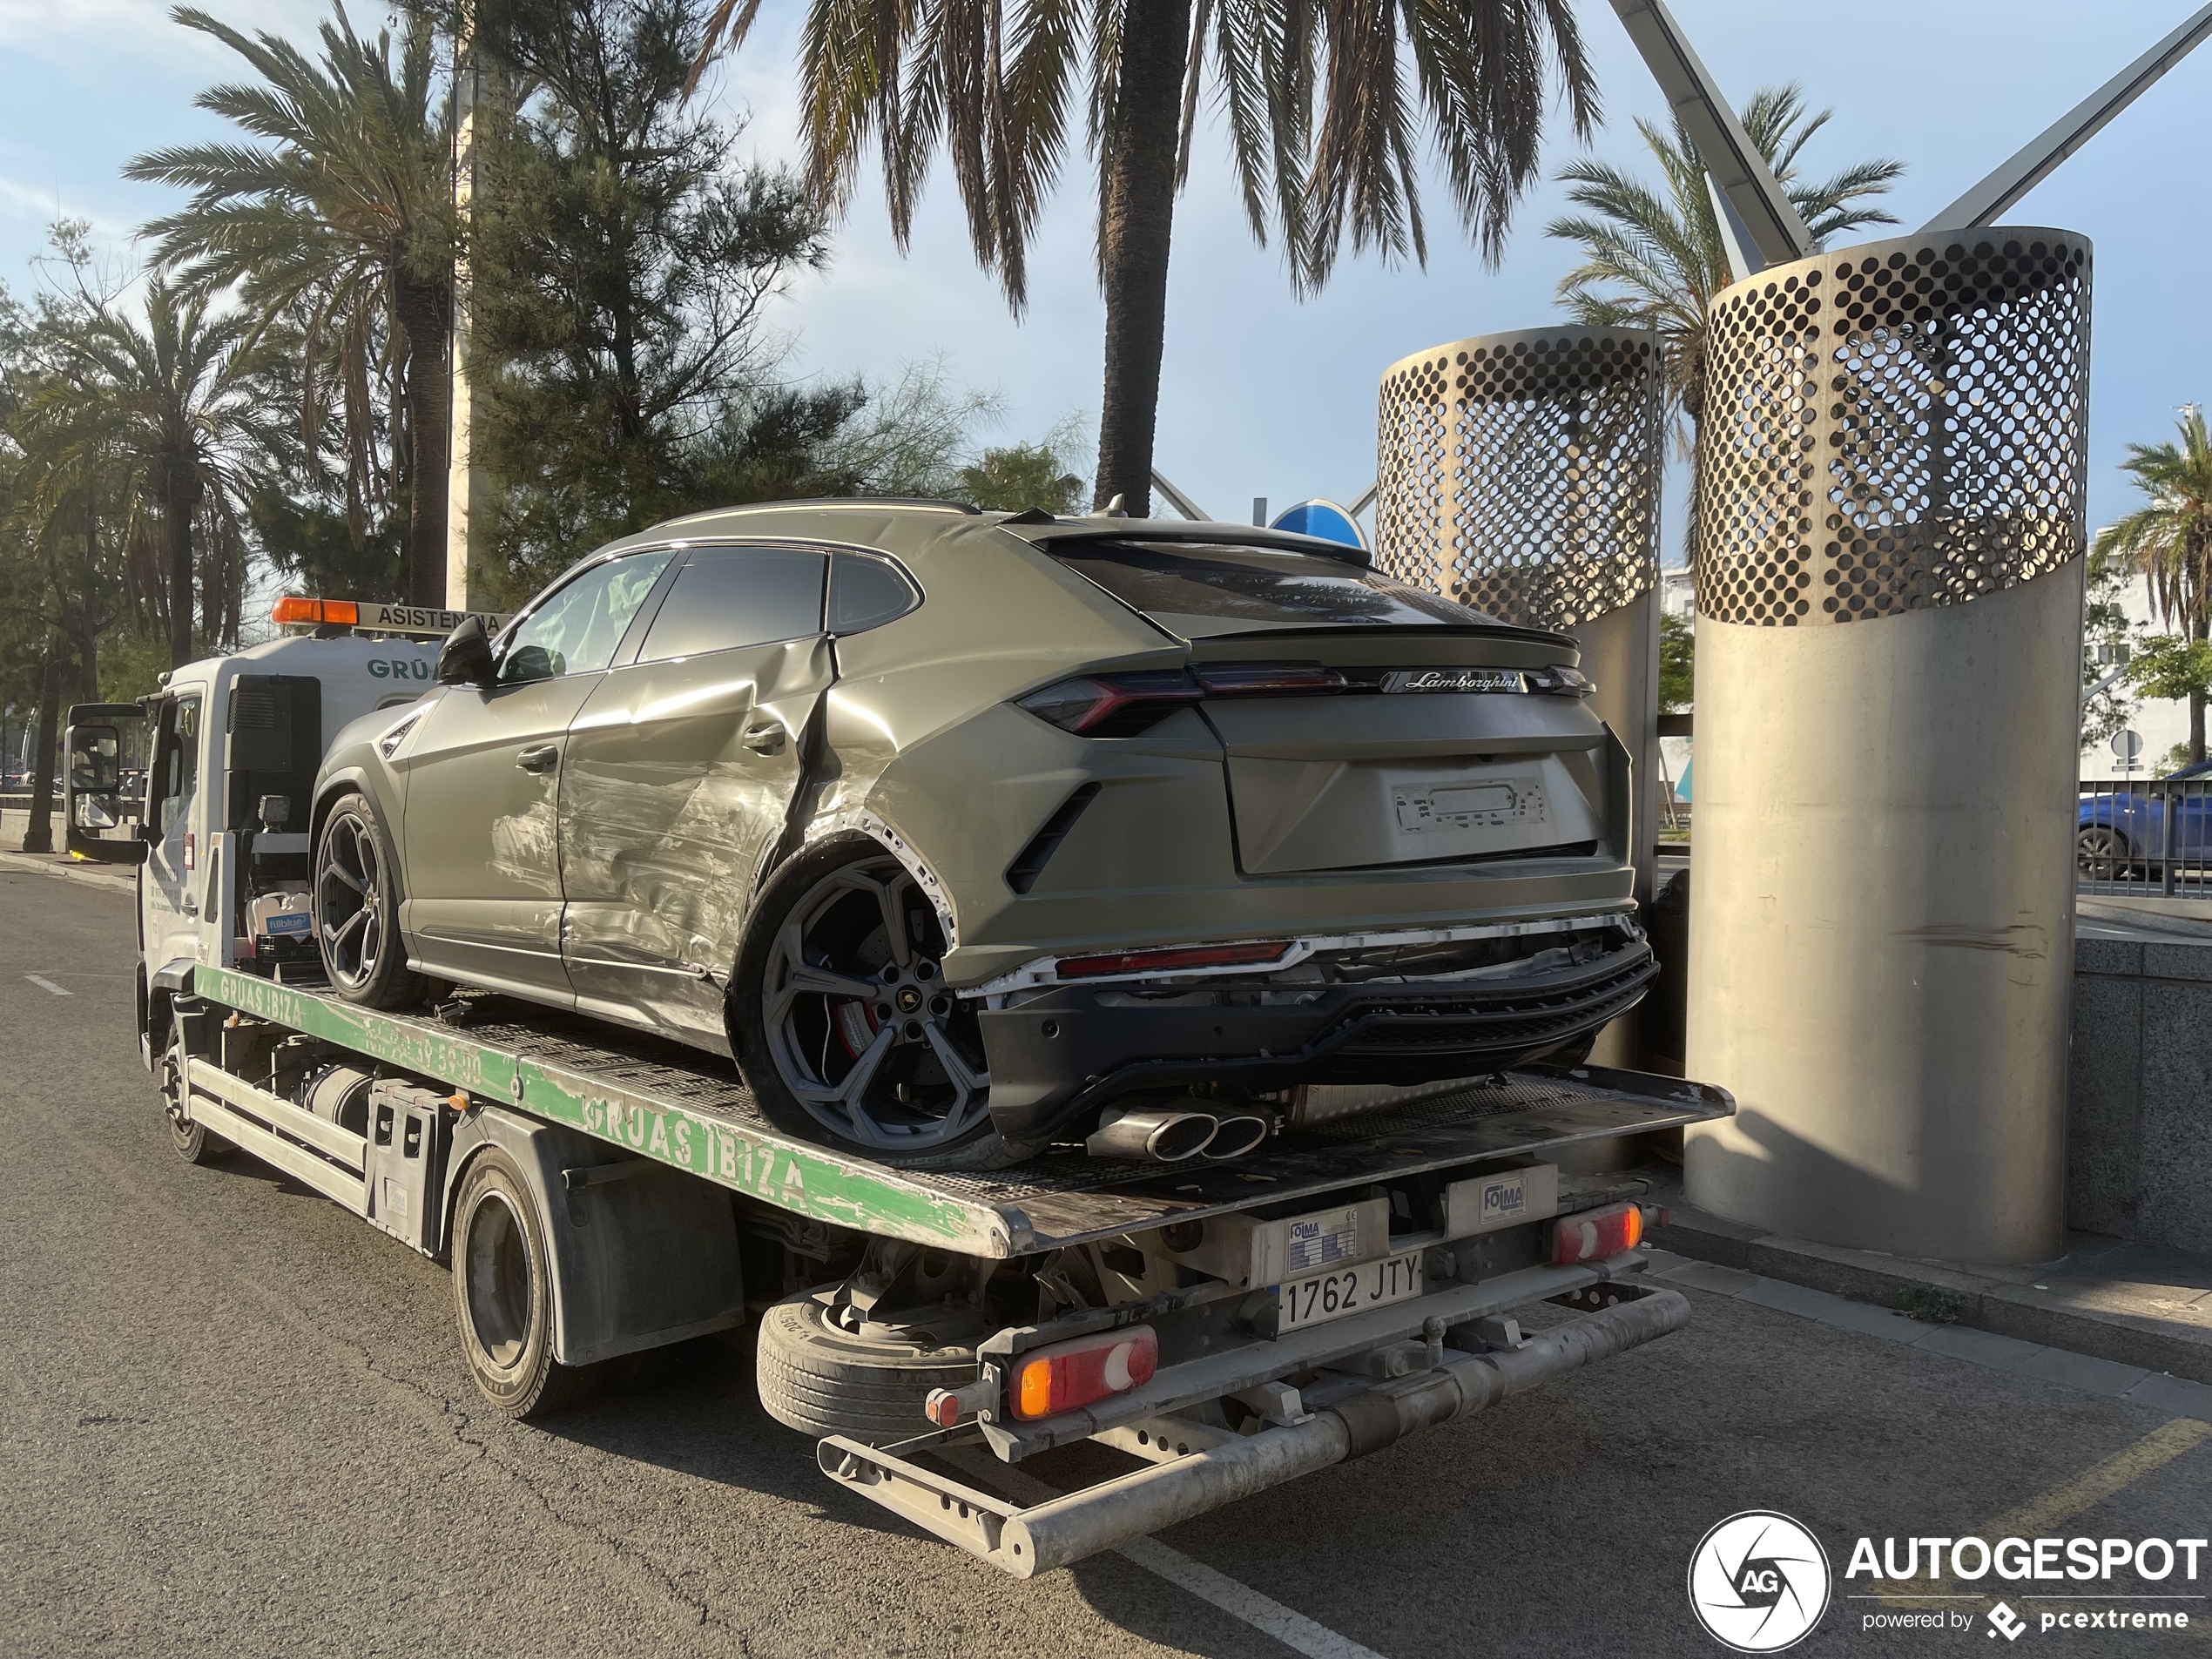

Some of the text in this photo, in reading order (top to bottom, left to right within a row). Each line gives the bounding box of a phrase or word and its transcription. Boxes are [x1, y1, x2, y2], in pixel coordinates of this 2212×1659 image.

[378, 607, 500, 631] ASISTENIA
[367, 658, 439, 681] GRÚ
[1405, 671, 1520, 691] Lamborghini
[220, 975, 302, 1028] GRÚAS IBIZA
[706, 1127, 808, 1210] IBIZA
[1287, 1255, 1419, 1323] 1762 JTY
